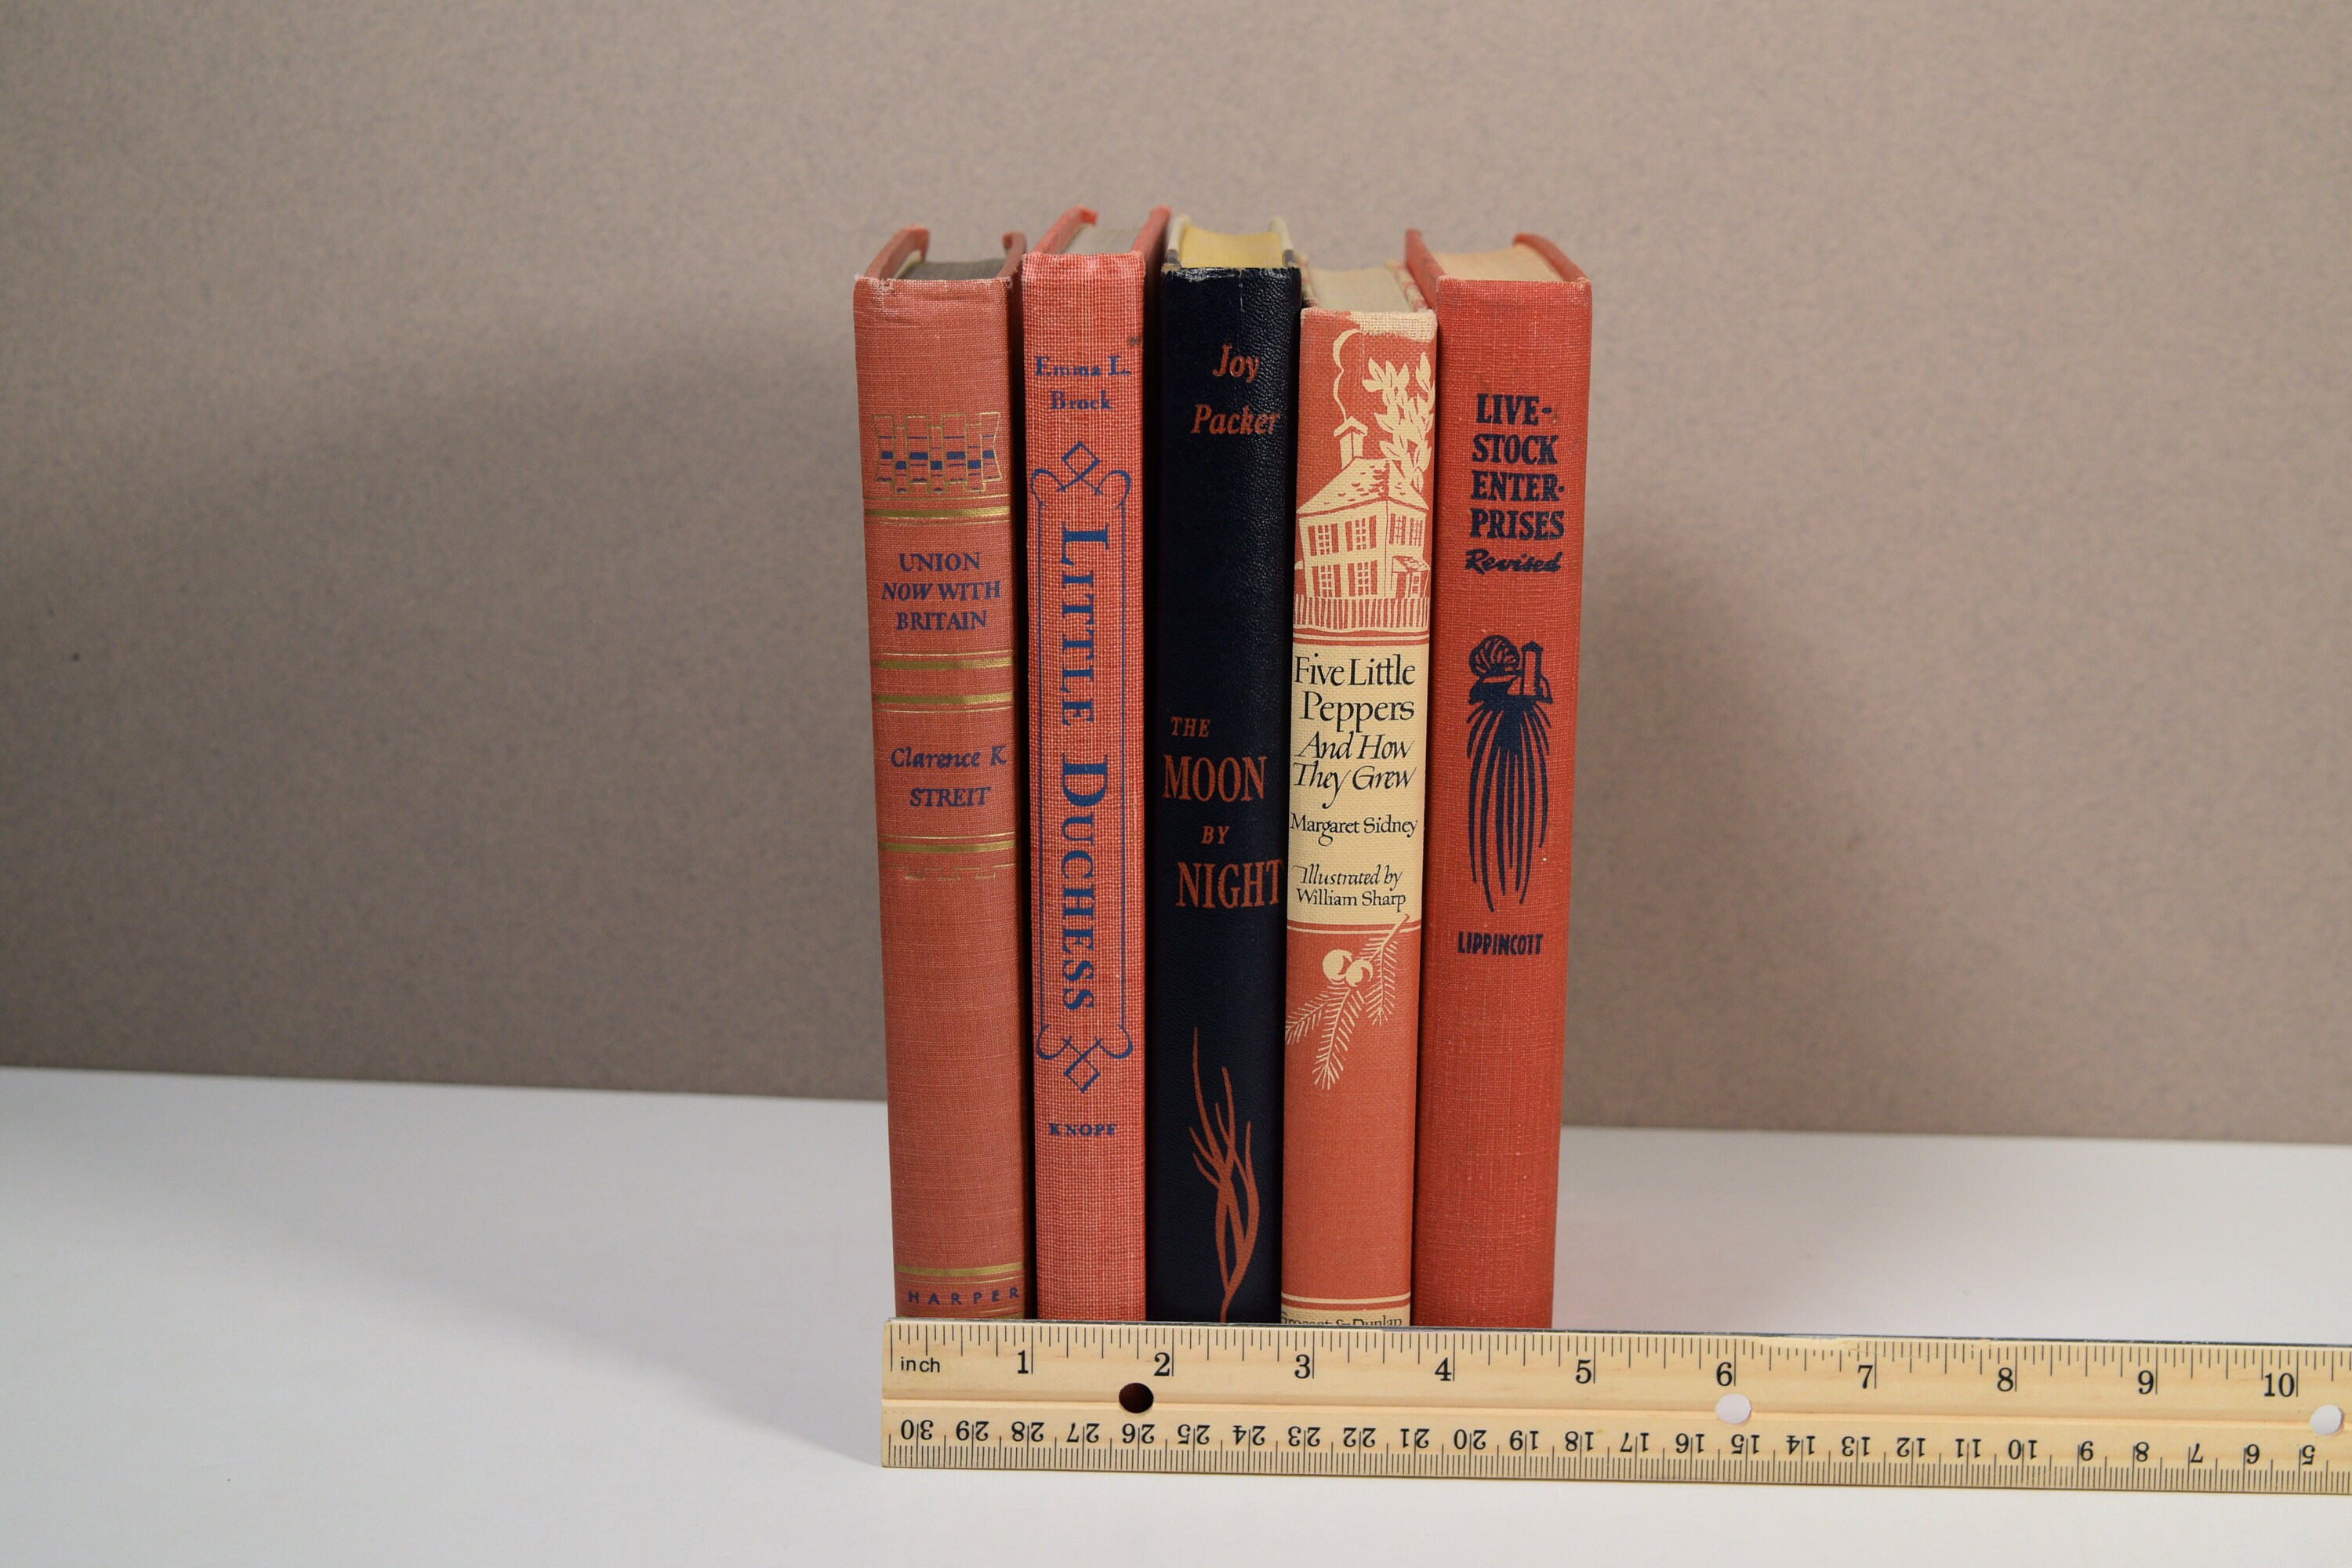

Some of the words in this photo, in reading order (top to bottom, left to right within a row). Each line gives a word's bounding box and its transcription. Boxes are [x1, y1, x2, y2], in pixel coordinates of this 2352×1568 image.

[1034, 355, 1101, 377] Emma
[1107, 355, 1131, 376] L.
[1212, 343, 1260, 383] Joy
[1050, 390, 1112, 411] Brock
[1475, 393, 1552, 426] LIVE-
[1190, 403, 1281, 435] Packer
[1472, 433, 1559, 466] STOCK
[1469, 507, 1566, 541] PRISES
[898, 551, 981, 572] UNION
[1465, 549, 1563, 575] Revised
[881, 583, 932, 601] NOW
[934, 579, 1001, 601] WITH
[895, 610, 987, 631] BRITAIN
[1060, 522, 1109, 727] LITTLE
[1294, 652, 1345, 687] Five
[1347, 653, 1417, 687] Little
[1298, 690, 1415, 733] Peppers
[1170, 716, 1211, 739] THE
[1294, 731, 1355, 760] And
[1356, 733, 1415, 760] How
[891, 746, 982, 769] Clarence
[1162, 753, 1268, 803] MOON
[1293, 759, 1352, 809] They
[1352, 764, 1417, 790] Grew
[909, 786, 992, 808] STREIT
[1200, 826, 1230, 845] BY
[1289, 812, 1360, 847] Margaret
[1363, 814, 1418, 839] Sidney
[1061, 753, 1109, 1011] DUCHESS
[1176, 858, 1284, 910] NIGHT
[1291, 863, 1380, 886] Illustrated
[1383, 864, 1403, 891] by
[1296, 887, 1358, 906] William
[1361, 889, 1406, 913] Sharp
[1457, 931, 1544, 956] LIPPINCOTT
[1047, 1123, 1117, 1136] KNOPF
[908, 1286, 1020, 1305] HARPER
[900, 1356, 941, 1374] inch
[1018, 1350, 1029, 1374] 1
[1153, 1352, 1171, 1377] 2
[1294, 1354, 1312, 1379] 3
[1435, 1357, 1453, 1381] 4
[1576, 1359, 1592, 1385] 5
[1715, 1362, 1733, 1387] 6
[1857, 1364, 1874, 1389] 7
[1997, 1367, 2014, 1392] 8
[2137, 1370, 2155, 1395] 9
[2263, 1373, 2296, 1398] 10
[900, 1419, 935, 1440] 30
[956, 1420, 989, 1441] 29
[1011, 1421, 1045, 1442] 28
[1066, 1422, 1100, 1443] 27
[1121, 1423, 1156, 1444] 26
[1178, 1424, 1210, 1445] 25
[1232, 1425, 1266, 1446] 24
[1288, 1425, 1321, 1447] 23
[1342, 1427, 1377, 1448] 22
[1400, 1428, 1430, 1449] 21
[1454, 1428, 1487, 1450] 20
[1509, 1429, 1540, 1450] 19
[1564, 1431, 1595, 1452] 18
[1620, 1432, 1650, 1453] 17
[1675, 1432, 1705, 1454] 16
[1730, 1434, 1761, 1455] 15
[1786, 1435, 1817, 1456] 14
[1841, 1436, 1871, 1457] 13
[1896, 1436, 1926, 1458] 12
[1955, 1438, 1982, 1459] 11
[2008, 1439, 2038, 1460] 10
[2079, 1440, 2094, 1461] 9
[2135, 1441, 2150, 1462] 8
[2190, 1443, 2204, 1464] 7
[2245, 1443, 2260, 1465] 6
[2301, 1445, 2316, 1466] 5
